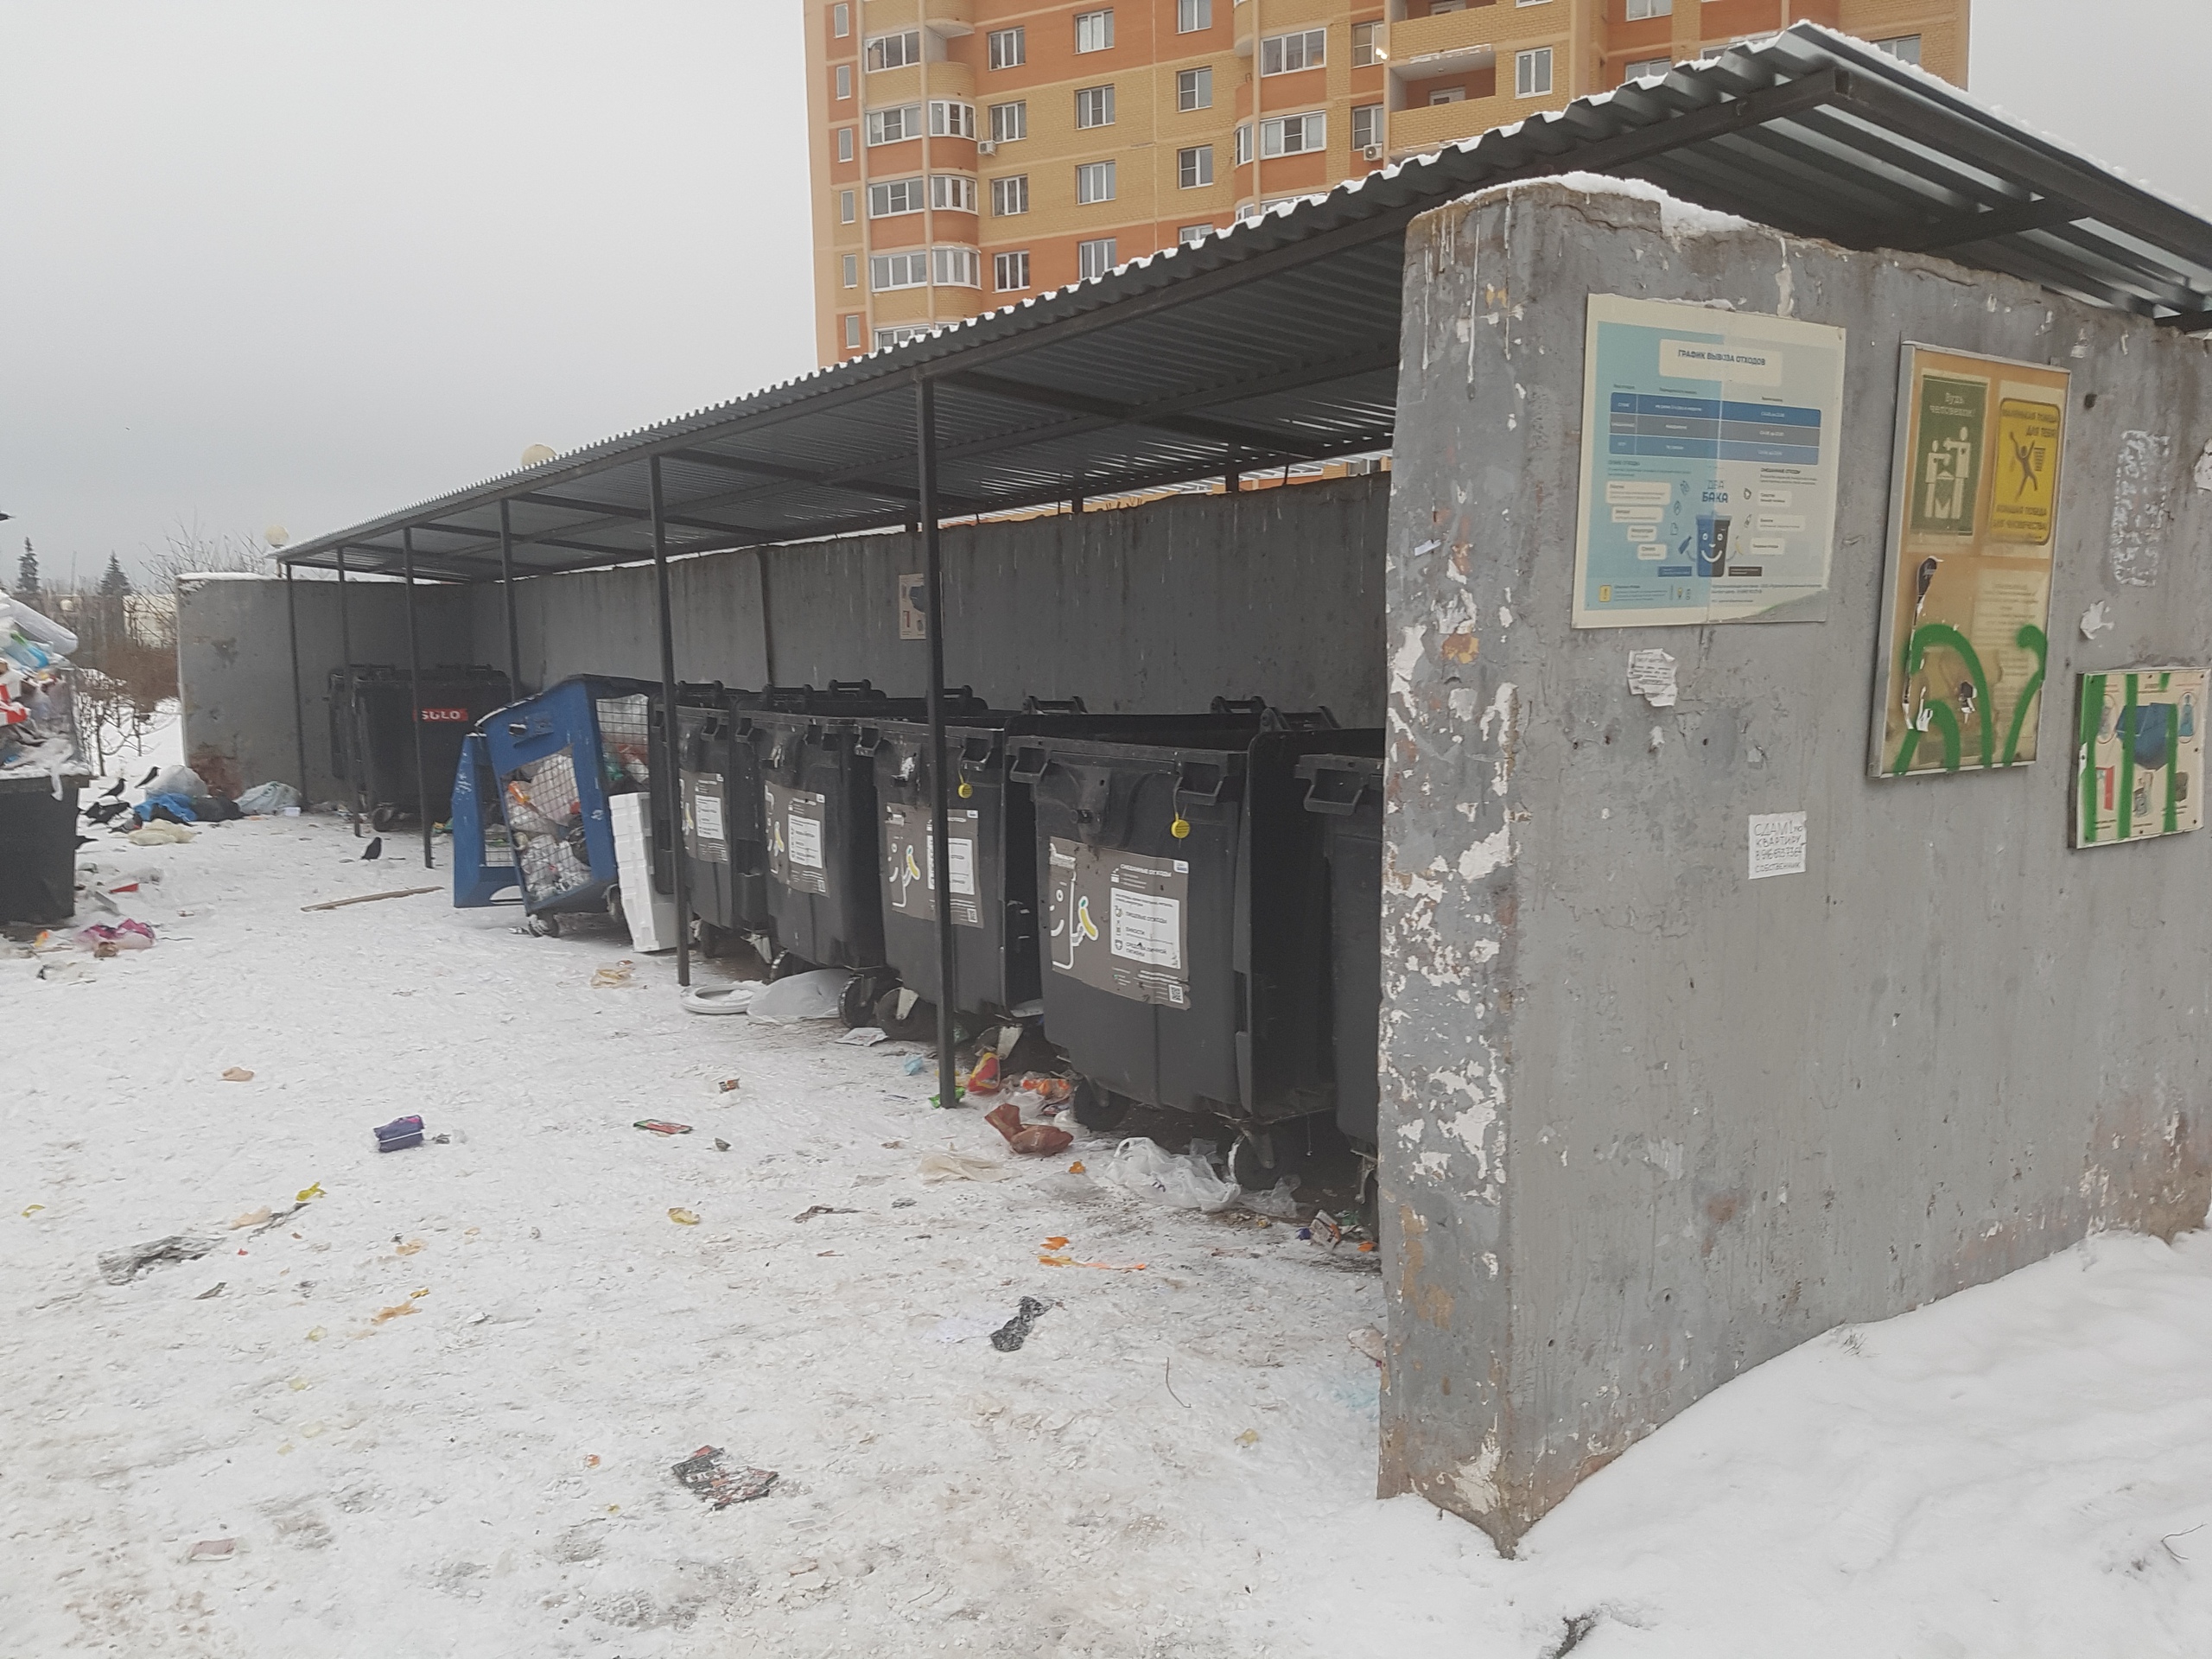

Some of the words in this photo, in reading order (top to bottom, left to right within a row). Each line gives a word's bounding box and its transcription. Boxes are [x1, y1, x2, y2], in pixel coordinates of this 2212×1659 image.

[1677, 349, 1706, 359] ГРАФИК
[1707, 353, 1734, 363] ВЫВОЗА
[1736, 356, 1766, 365] ОТХОДОВ
[1702, 492, 1728, 503] БАКА
